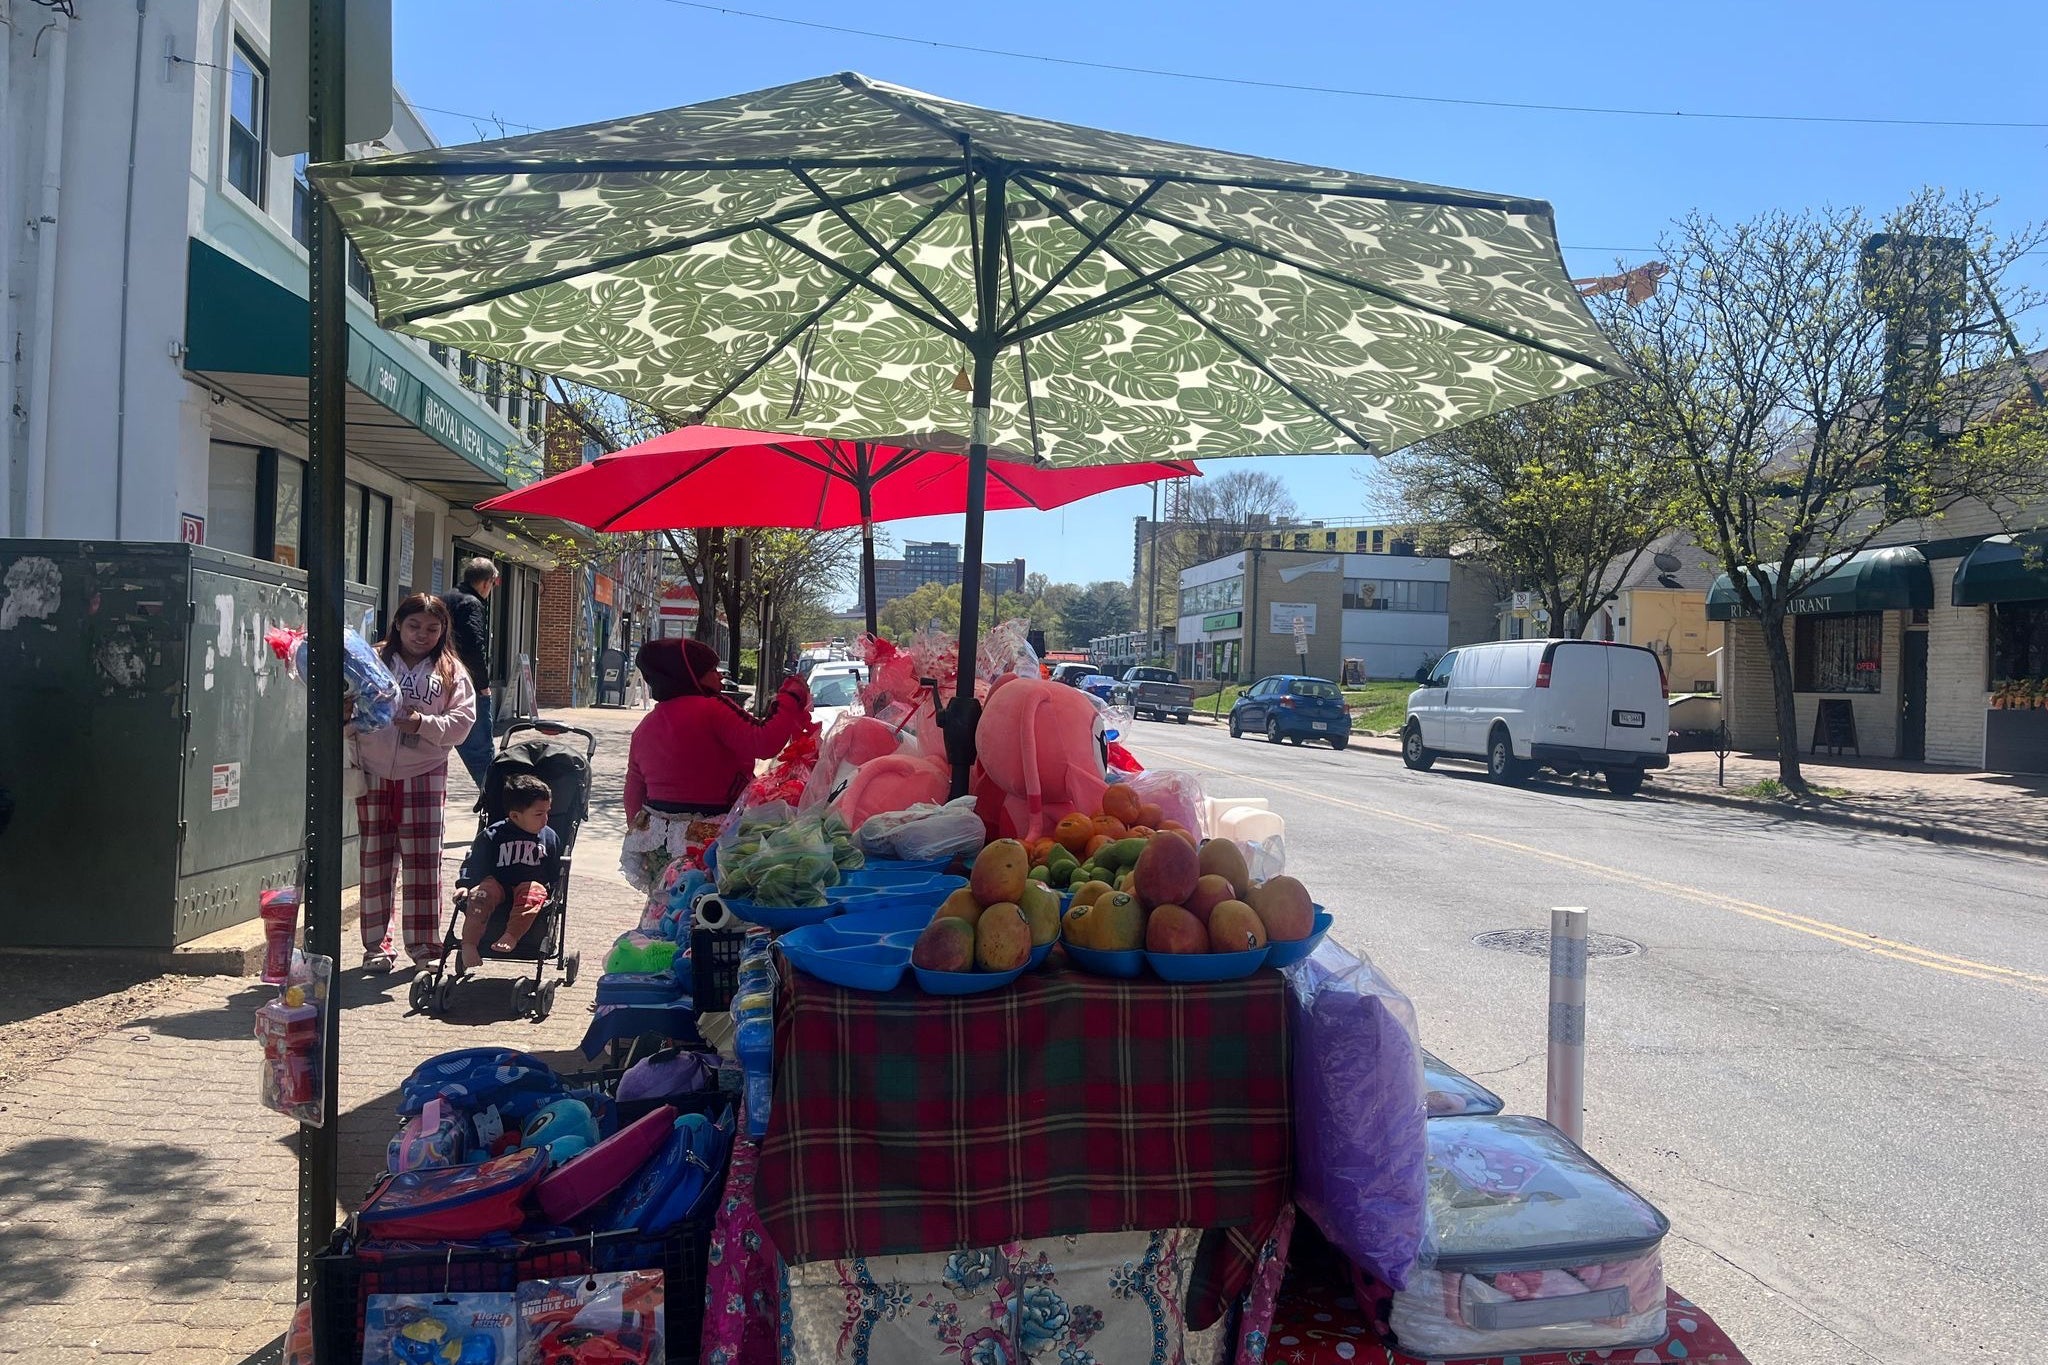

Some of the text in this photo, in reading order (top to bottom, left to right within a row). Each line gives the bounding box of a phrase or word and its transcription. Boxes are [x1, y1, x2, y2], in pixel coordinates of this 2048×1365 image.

[433, 401, 485, 461] ROYAL NEPAL
[1856, 661, 1876, 670] OPEN
[399, 673, 442, 705] AP
[521, 1299, 585, 1317] BUBBLE GUN
